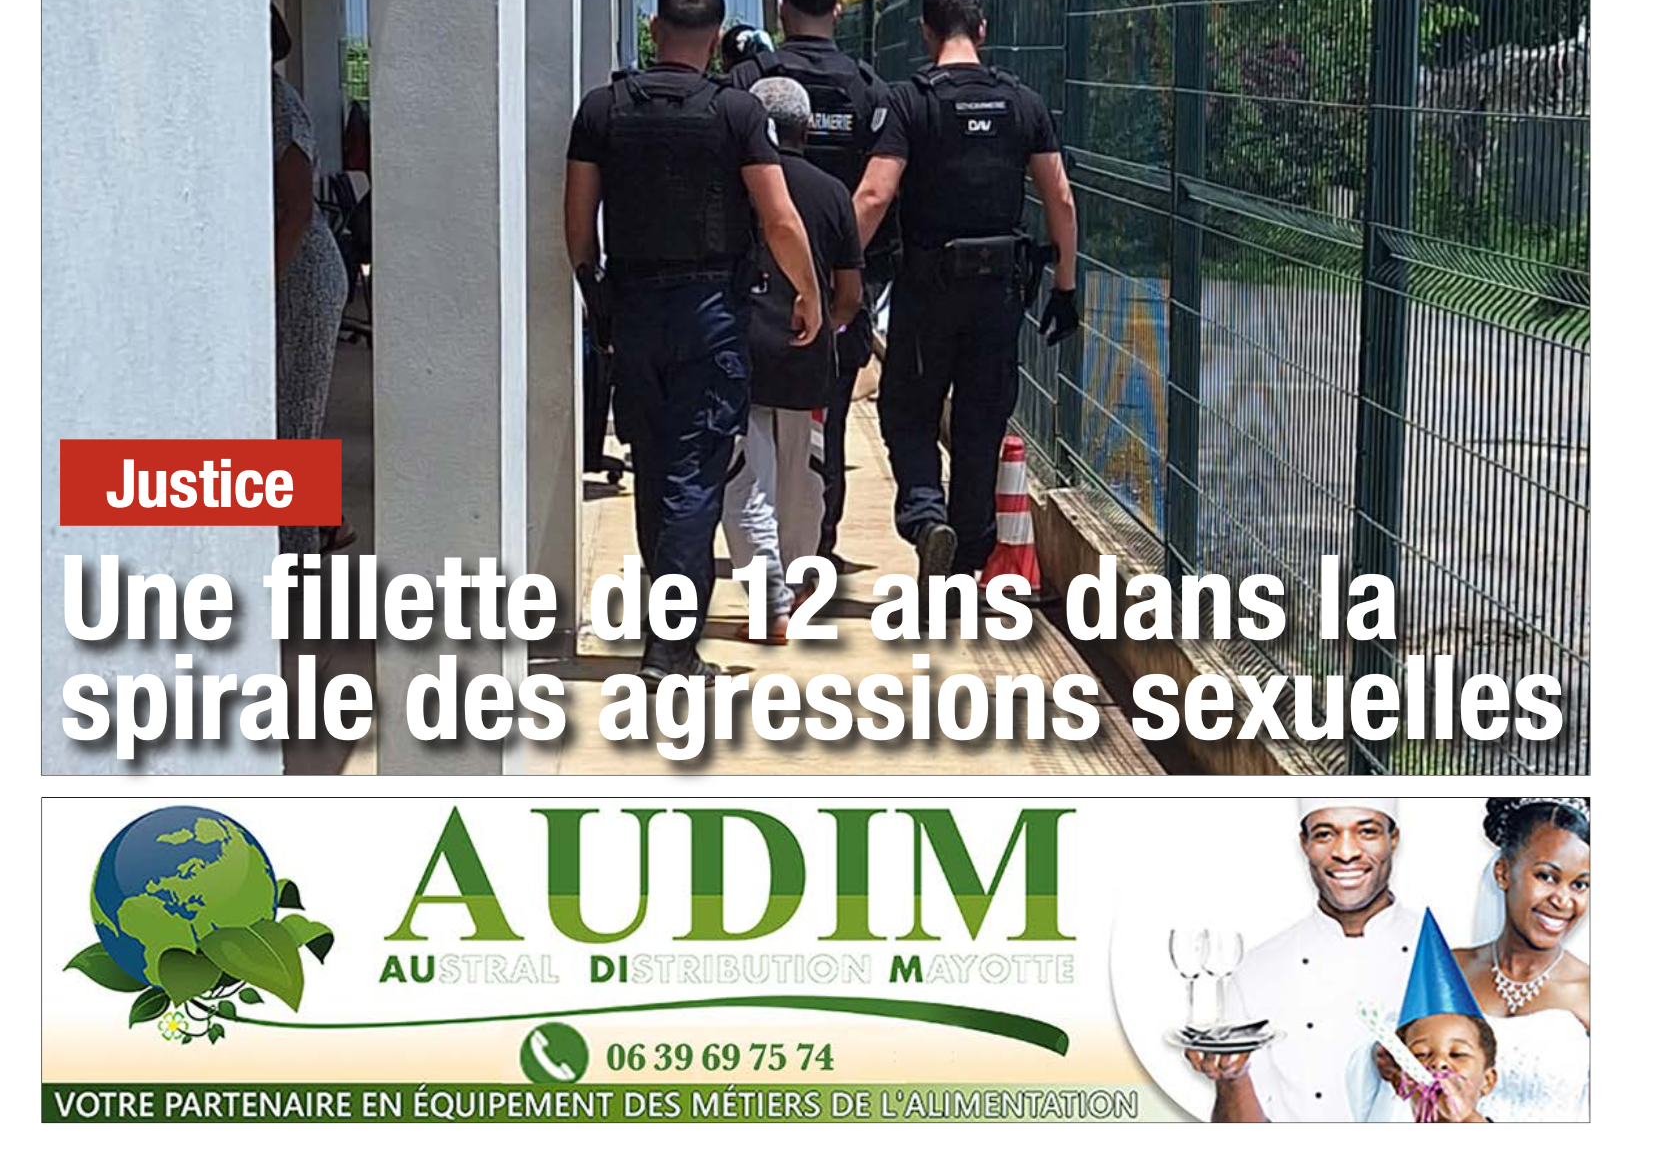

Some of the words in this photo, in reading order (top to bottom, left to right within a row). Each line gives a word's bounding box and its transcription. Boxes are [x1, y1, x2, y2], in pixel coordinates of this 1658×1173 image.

[807, 112, 853, 131] ARMERIE
[106, 458, 294, 509] Justice
[62, 554, 233, 641] Une
[263, 553, 557, 641] fillette
[590, 554, 698, 641] de
[733, 555, 838, 640] 12
[870, 573, 1033, 641] ans
[1066, 554, 1286, 641] dans
[1321, 554, 1397, 641] la
[62, 653, 373, 759] spirale
[406, 654, 566, 741] des
[598, 653, 1100, 760] agressions
[1132, 654, 1563, 741] sexuelles
[383, 806, 1079, 944] AUDIM
[379, 953, 560, 984] AUSTRAL
[590, 953, 872, 984] DISTRIBUTION
[889, 953, 1074, 984] MAYOTTE
[606, 1043, 646, 1072] 06
[654, 1043, 694, 1072] 39
[701, 1043, 741, 1072] 69
[749, 1042, 787, 1071] 75
[796, 1042, 834, 1071] 74
[54, 1092, 155, 1118] VOTRE
[165, 1092, 352, 1117] PARTENAIRE
[363, 1092, 402, 1117] EN
[413, 1084, 615, 1120] ÉQUIPEMENT
[624, 1092, 682, 1118] DES
[692, 1084, 821, 1118] MÉTIERS
[831, 1092, 871, 1117] DE
[881, 1091, 1139, 1118] L'ALIMENTATION
